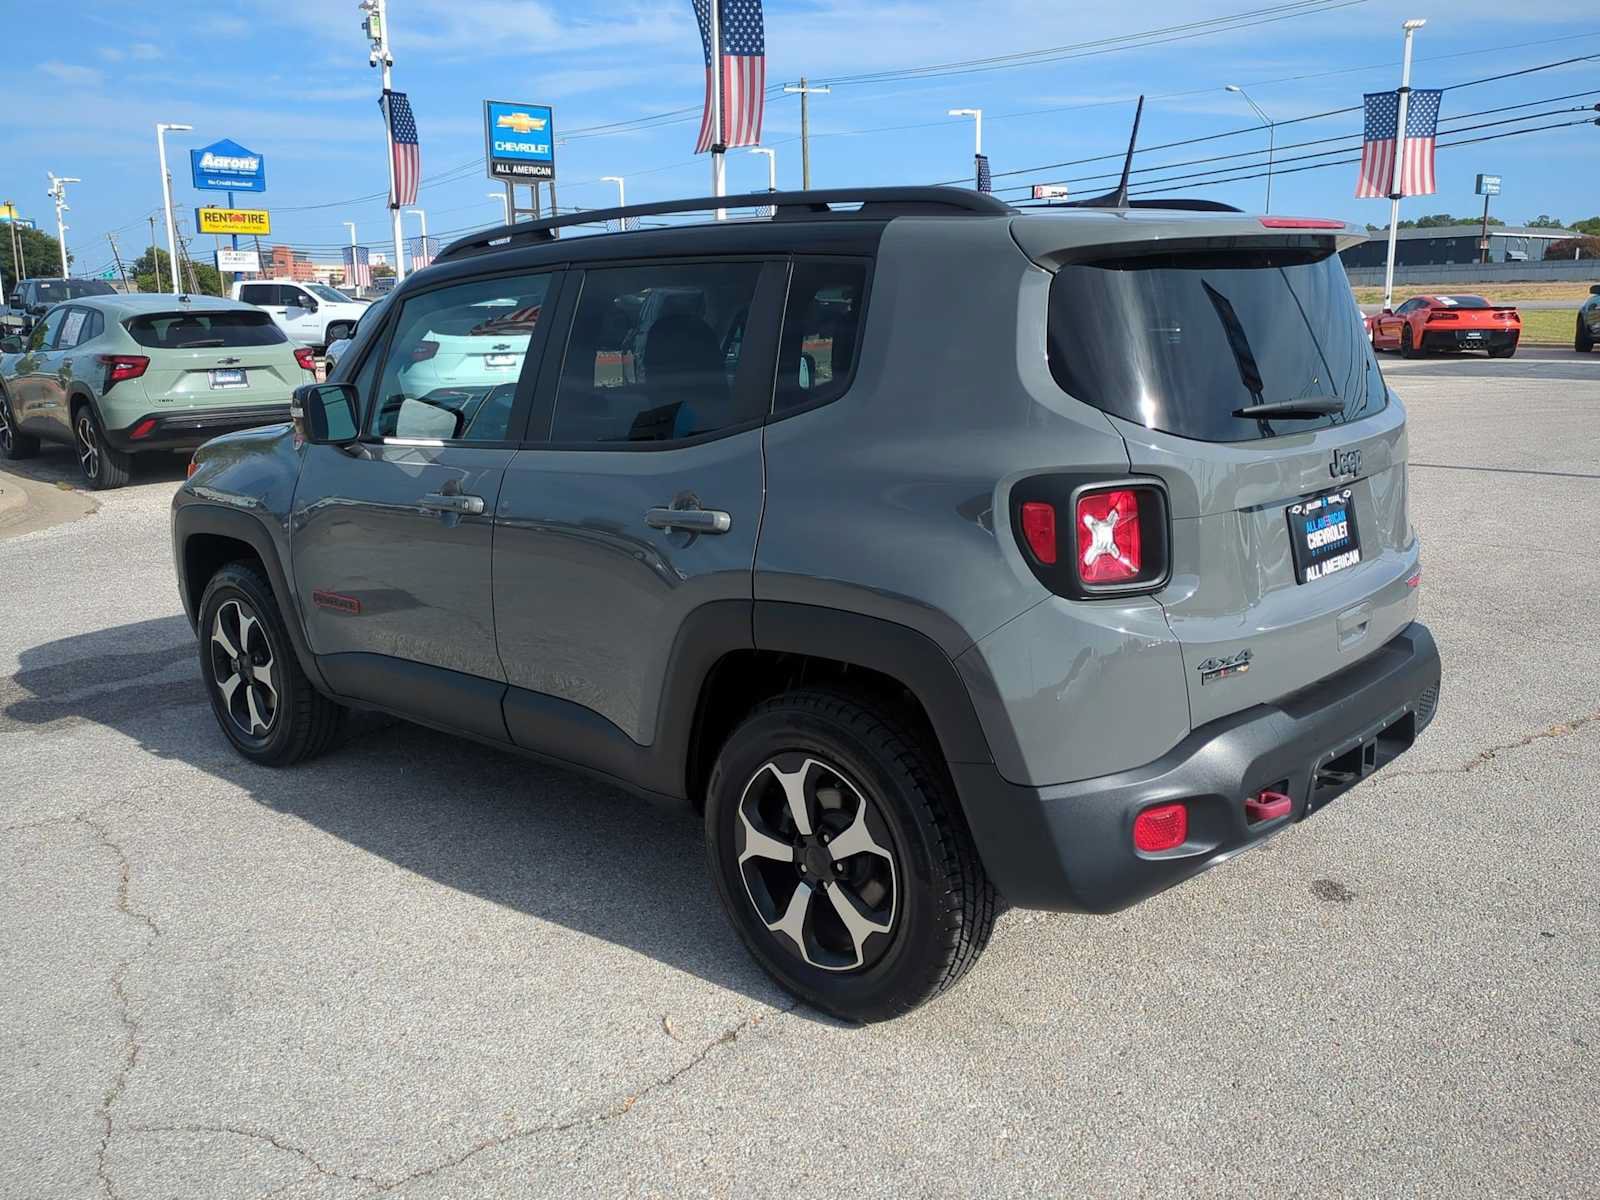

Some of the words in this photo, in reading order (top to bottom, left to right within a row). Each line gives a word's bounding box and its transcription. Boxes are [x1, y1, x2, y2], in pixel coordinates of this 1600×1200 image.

[495, 141, 549, 154] CHEVROLET
[200, 152, 259, 171] Aaron's
[496, 164, 511, 173] ALL
[512, 165, 551, 176] AMERICAN
[204, 212, 232, 223] RENT
[242, 214, 266, 224] TIRE
[1329, 448, 1362, 478] Jeep
[1306, 518, 1319, 533] ALL
[1317, 511, 1347, 530] AMERICAN
[1306, 521, 1348, 549] CHEVROLET
[1306, 563, 1323, 582] ALL
[1321, 550, 1360, 576] AMERICAN
